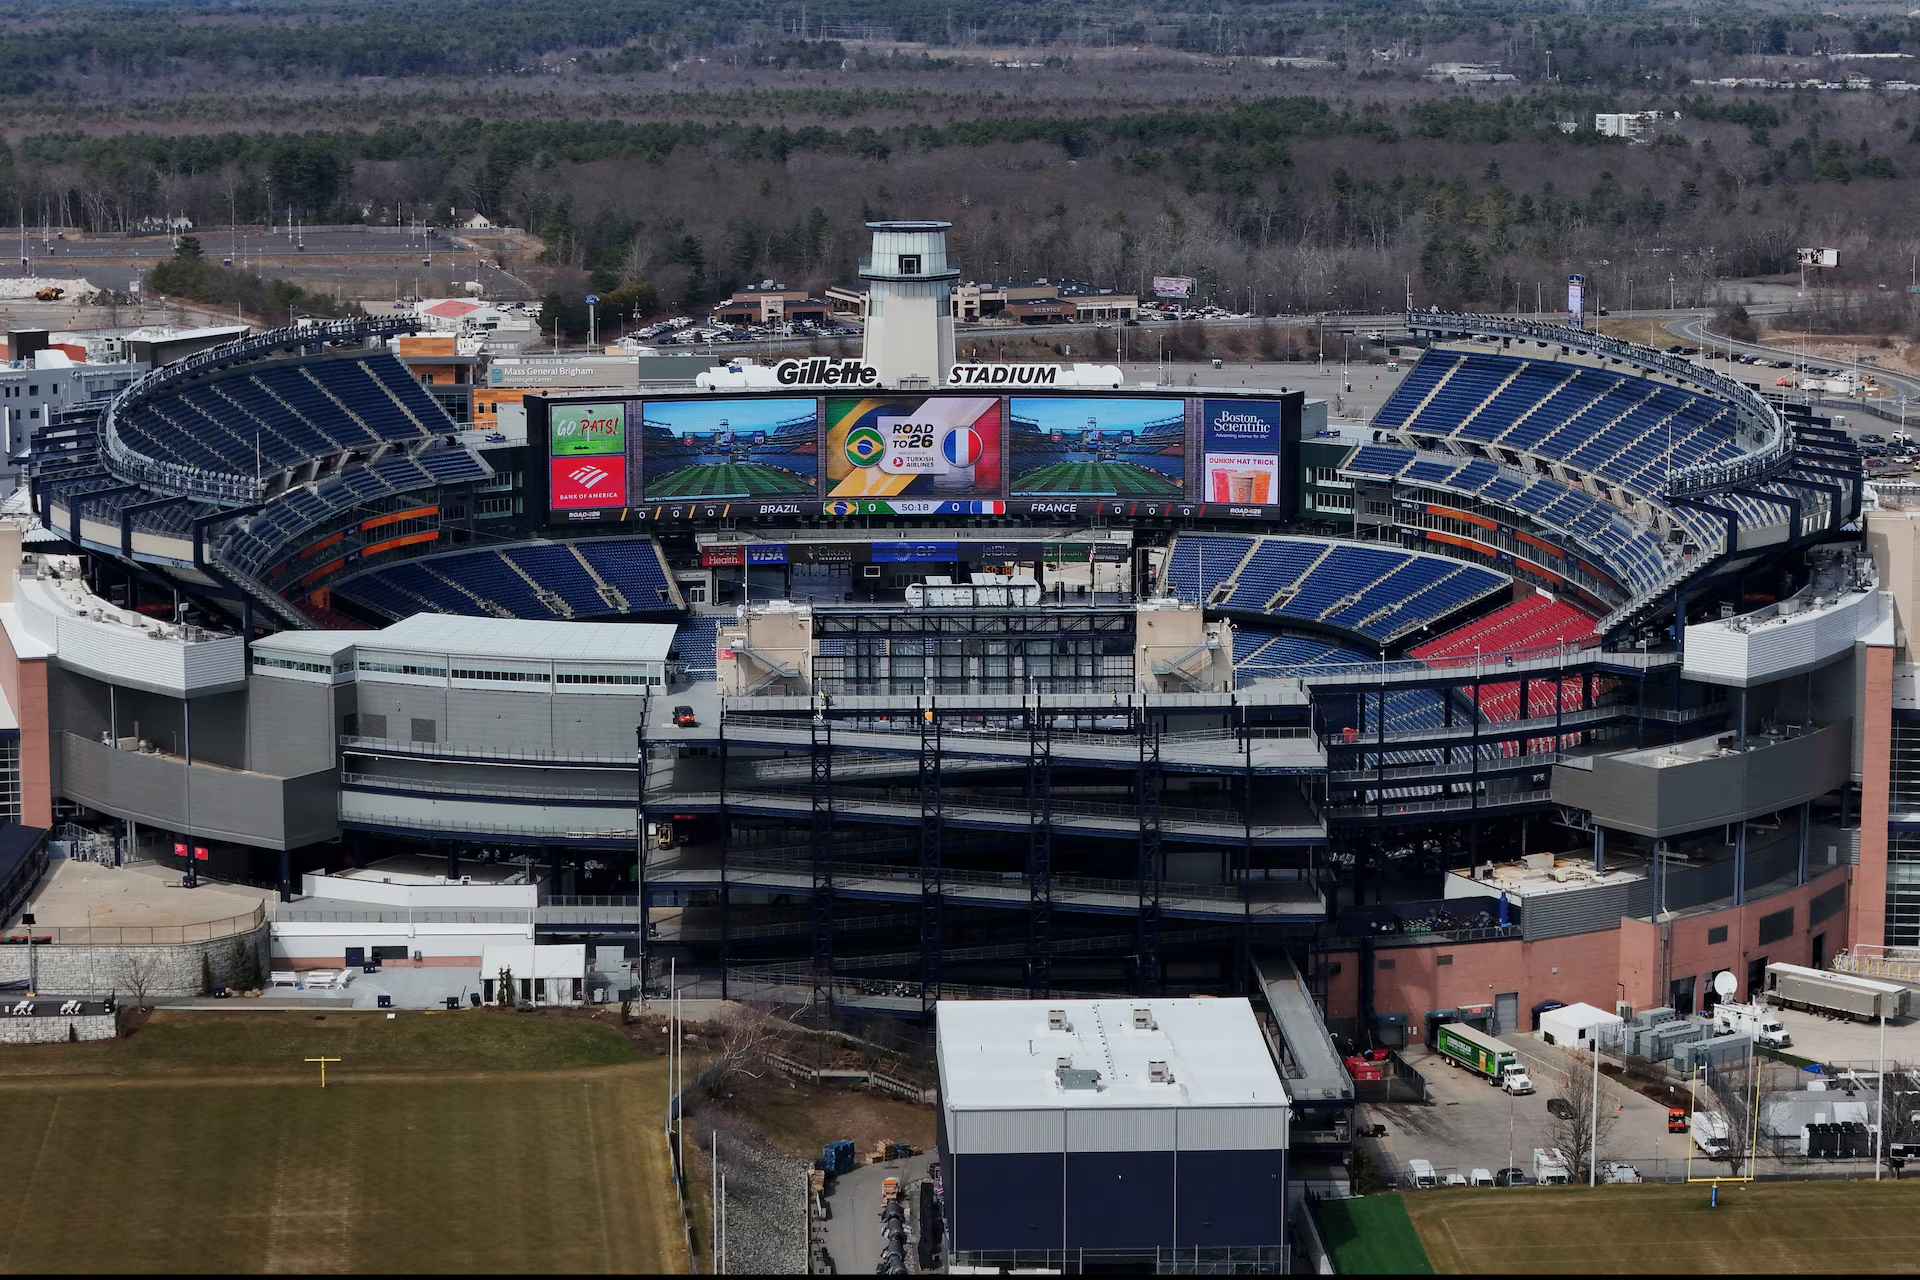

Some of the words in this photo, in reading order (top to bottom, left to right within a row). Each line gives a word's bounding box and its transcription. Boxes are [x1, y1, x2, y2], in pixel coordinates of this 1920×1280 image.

[504, 368, 525, 376] Mass
[559, 367, 594, 377] Brigham
[777, 359, 877, 385] Gillette
[950, 367, 1057, 384] STADIUM
[1221, 410, 1257, 423] Boston
[557, 420, 577, 437] GO
[580, 417, 619, 436] PATS!
[892, 424, 934, 434] ROAD
[1213, 418, 1271, 433] Scientific
[893, 440, 908, 448] TO
[760, 504, 800, 514] BRAZIL
[868, 503, 877, 512] 0
[901, 503, 930, 512] 50:18
[951, 503, 960, 512] 0
[1030, 503, 1078, 513] FRANCE
[1114, 507, 1121, 515] 0
[1149, 507, 1156, 515] 0
[1183, 508, 1190, 516] 0
[639, 511, 646, 519] 0
[672, 510, 680, 518] 0
[707, 509, 715, 517] 0
[752, 547, 784, 561] VISA
[981, 544, 1018, 558] jetBlue
[985, 566, 1012, 576] 50:18
